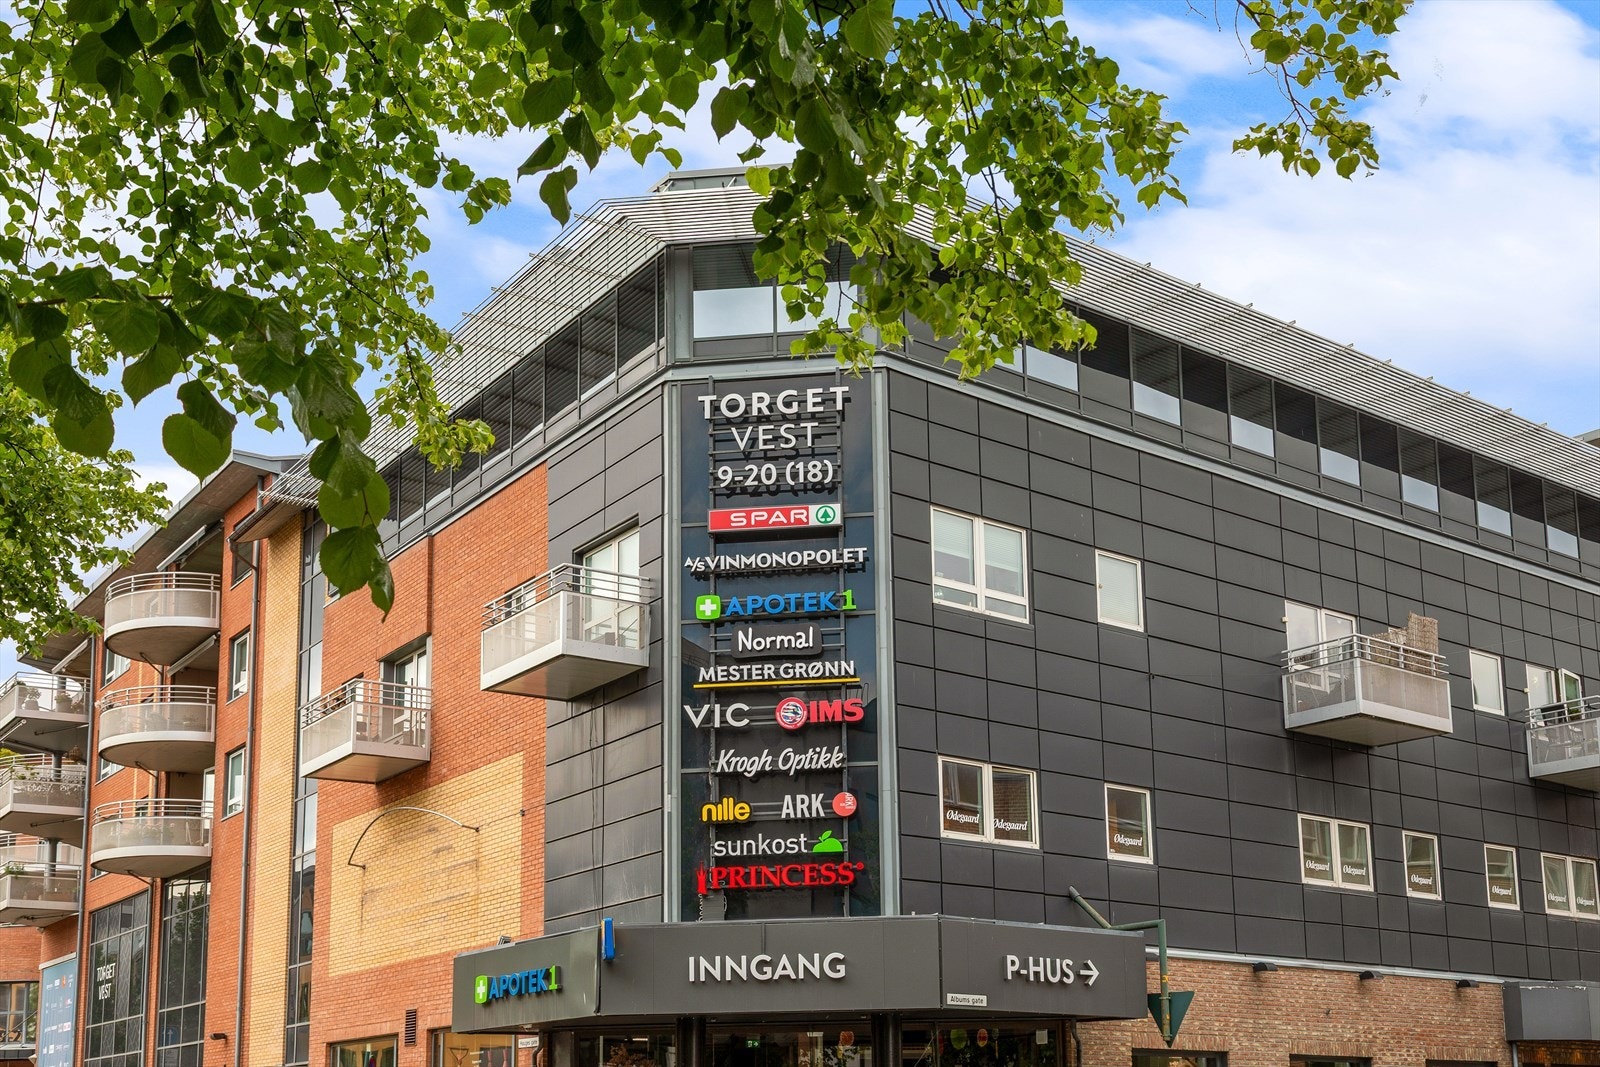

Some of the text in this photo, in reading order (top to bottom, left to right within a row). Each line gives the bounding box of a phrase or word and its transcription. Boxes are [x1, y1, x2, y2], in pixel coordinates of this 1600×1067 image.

[698, 386, 849, 420] TORGET
[731, 422, 818, 451] VEST
[717, 460, 833, 488] 9-20 (18)
[730, 508, 807, 527] SPAR
[705, 547, 868, 571] VINMONOPOLET
[737, 626, 814, 652] Normal
[698, 660, 855, 682] MESTER GRØNN
[684, 703, 750, 728] VIC
[809, 698, 864, 723] IMS
[716, 746, 843, 777] Krogh Optikk
[701, 796, 752, 822] nille
[781, 793, 825, 819] ARK
[946, 810, 979, 825] Ødegaard
[993, 818, 1028, 832] Ødegaard
[714, 833, 807, 857] sunkost
[1114, 834, 1142, 847] Ødegaard
[711, 863, 855, 889] PRINCESS
[689, 952, 845, 984] INNGANG
[1006, 954, 1074, 985] P-HUS
[950, 996, 970, 1004] Albums
